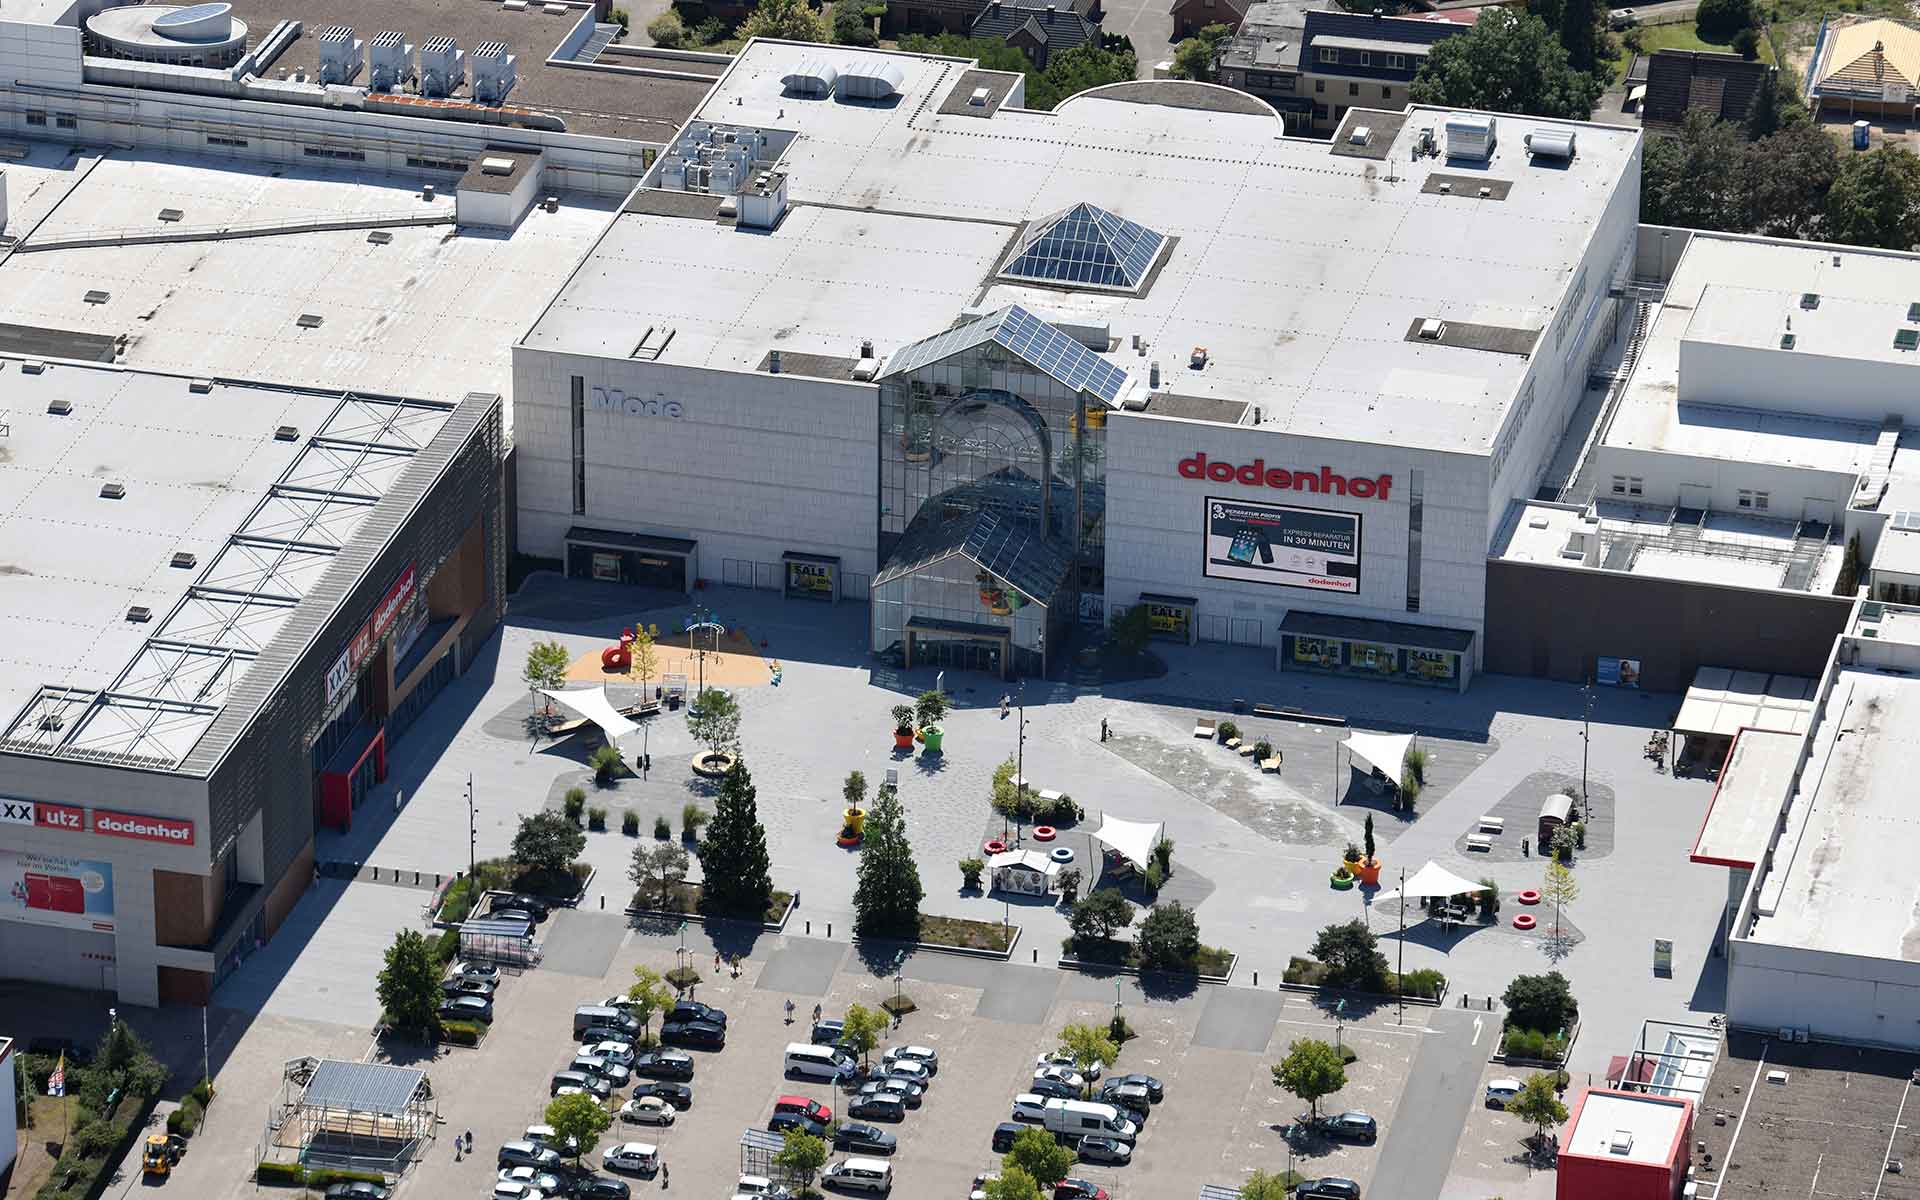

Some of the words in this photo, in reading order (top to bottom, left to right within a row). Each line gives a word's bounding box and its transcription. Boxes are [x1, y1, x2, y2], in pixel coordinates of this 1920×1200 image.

[592, 386, 682, 417] Mode
[1178, 452, 1391, 500] dodenhof
[1283, 528, 1312, 537] EXPRESS
[1313, 532, 1351, 541] REPARATUR
[1283, 535, 1293, 543] IN
[1308, 538, 1351, 550] MINUTEN
[791, 565, 825, 577] SALE
[1308, 577, 1351, 588] dodenhof
[374, 571, 414, 632] dodenhof
[1151, 606, 1182, 617] SALE
[1298, 643, 1338, 657] SALE
[1411, 650, 1443, 662] SALE
[98, 818, 190, 840] dodenhof
